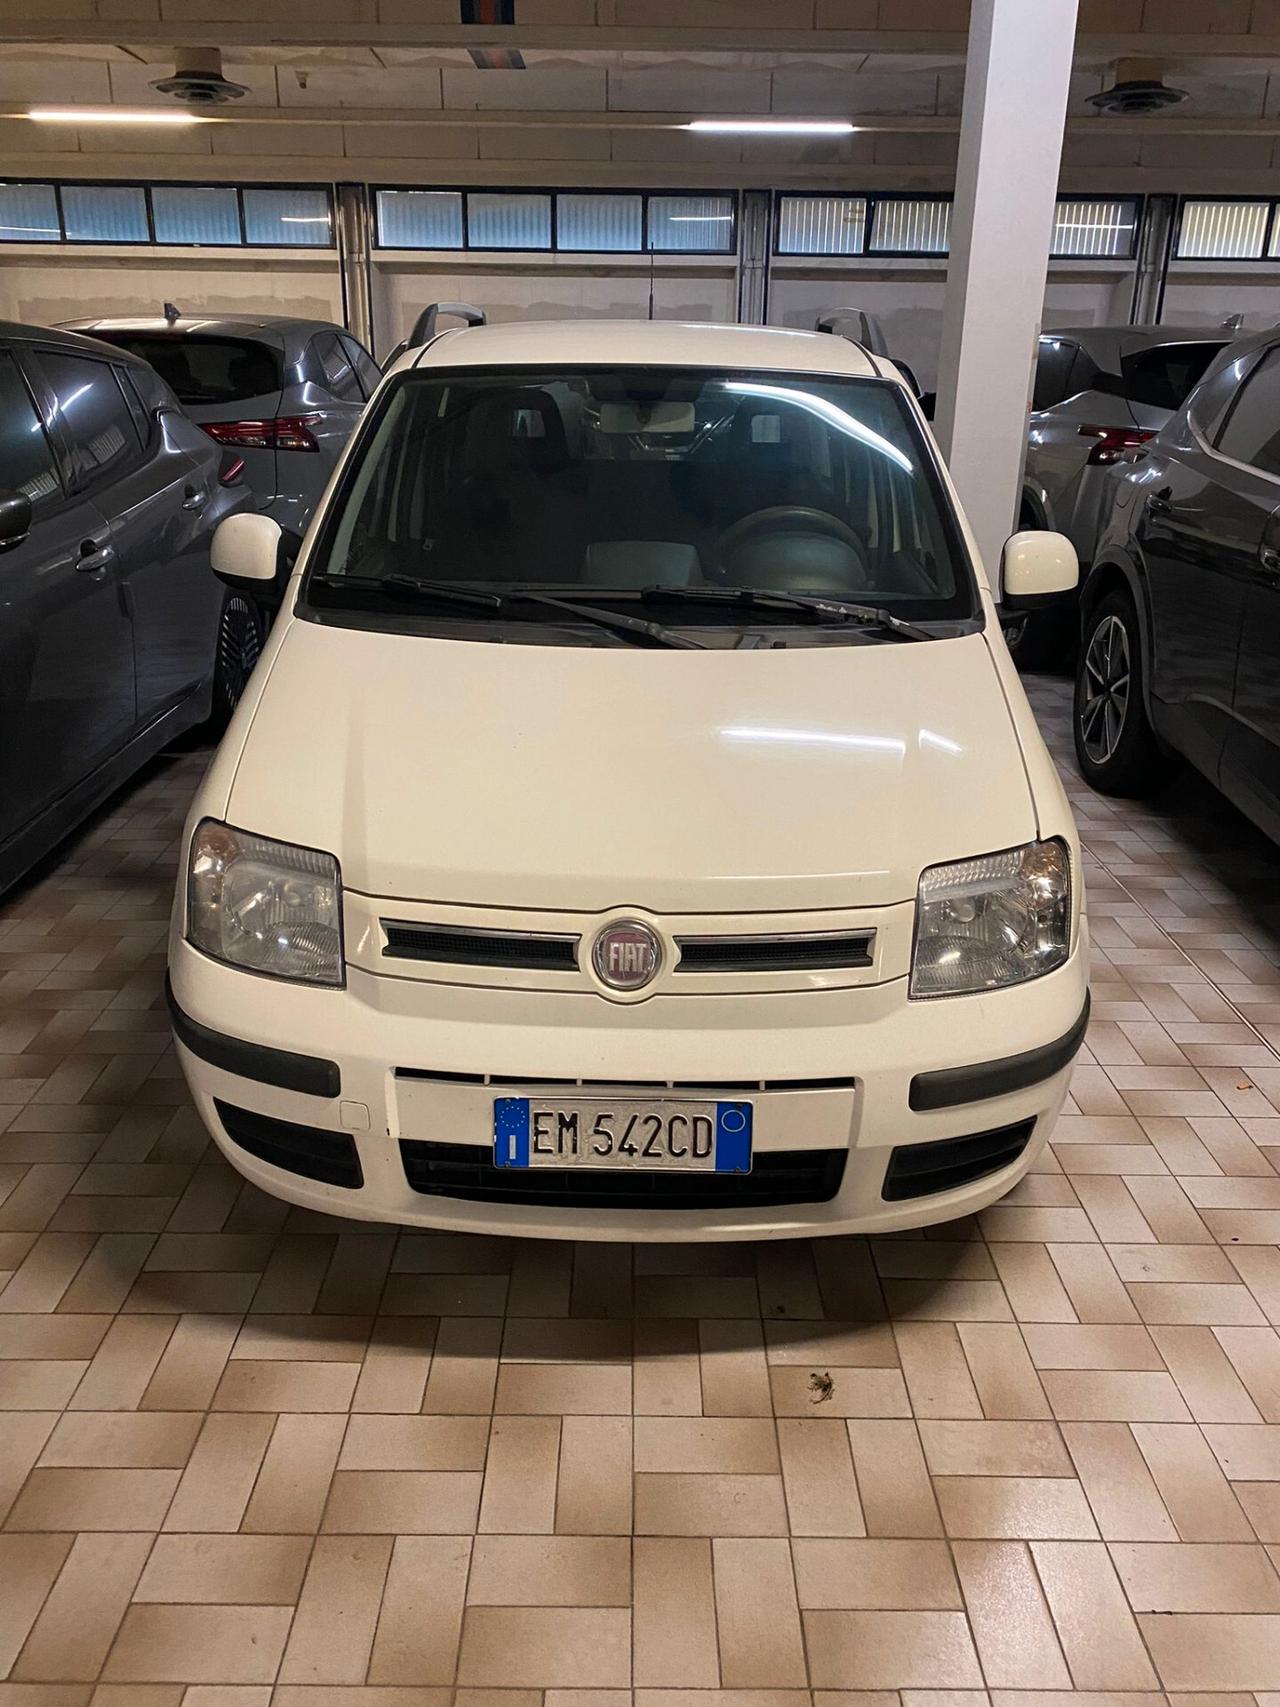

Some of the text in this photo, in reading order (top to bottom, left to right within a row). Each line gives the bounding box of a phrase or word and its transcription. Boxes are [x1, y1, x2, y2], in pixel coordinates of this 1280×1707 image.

[609, 942, 647, 972] FIAT
[509, 1135, 516, 1160] I
[533, 1112, 713, 1158] EM 542CD
